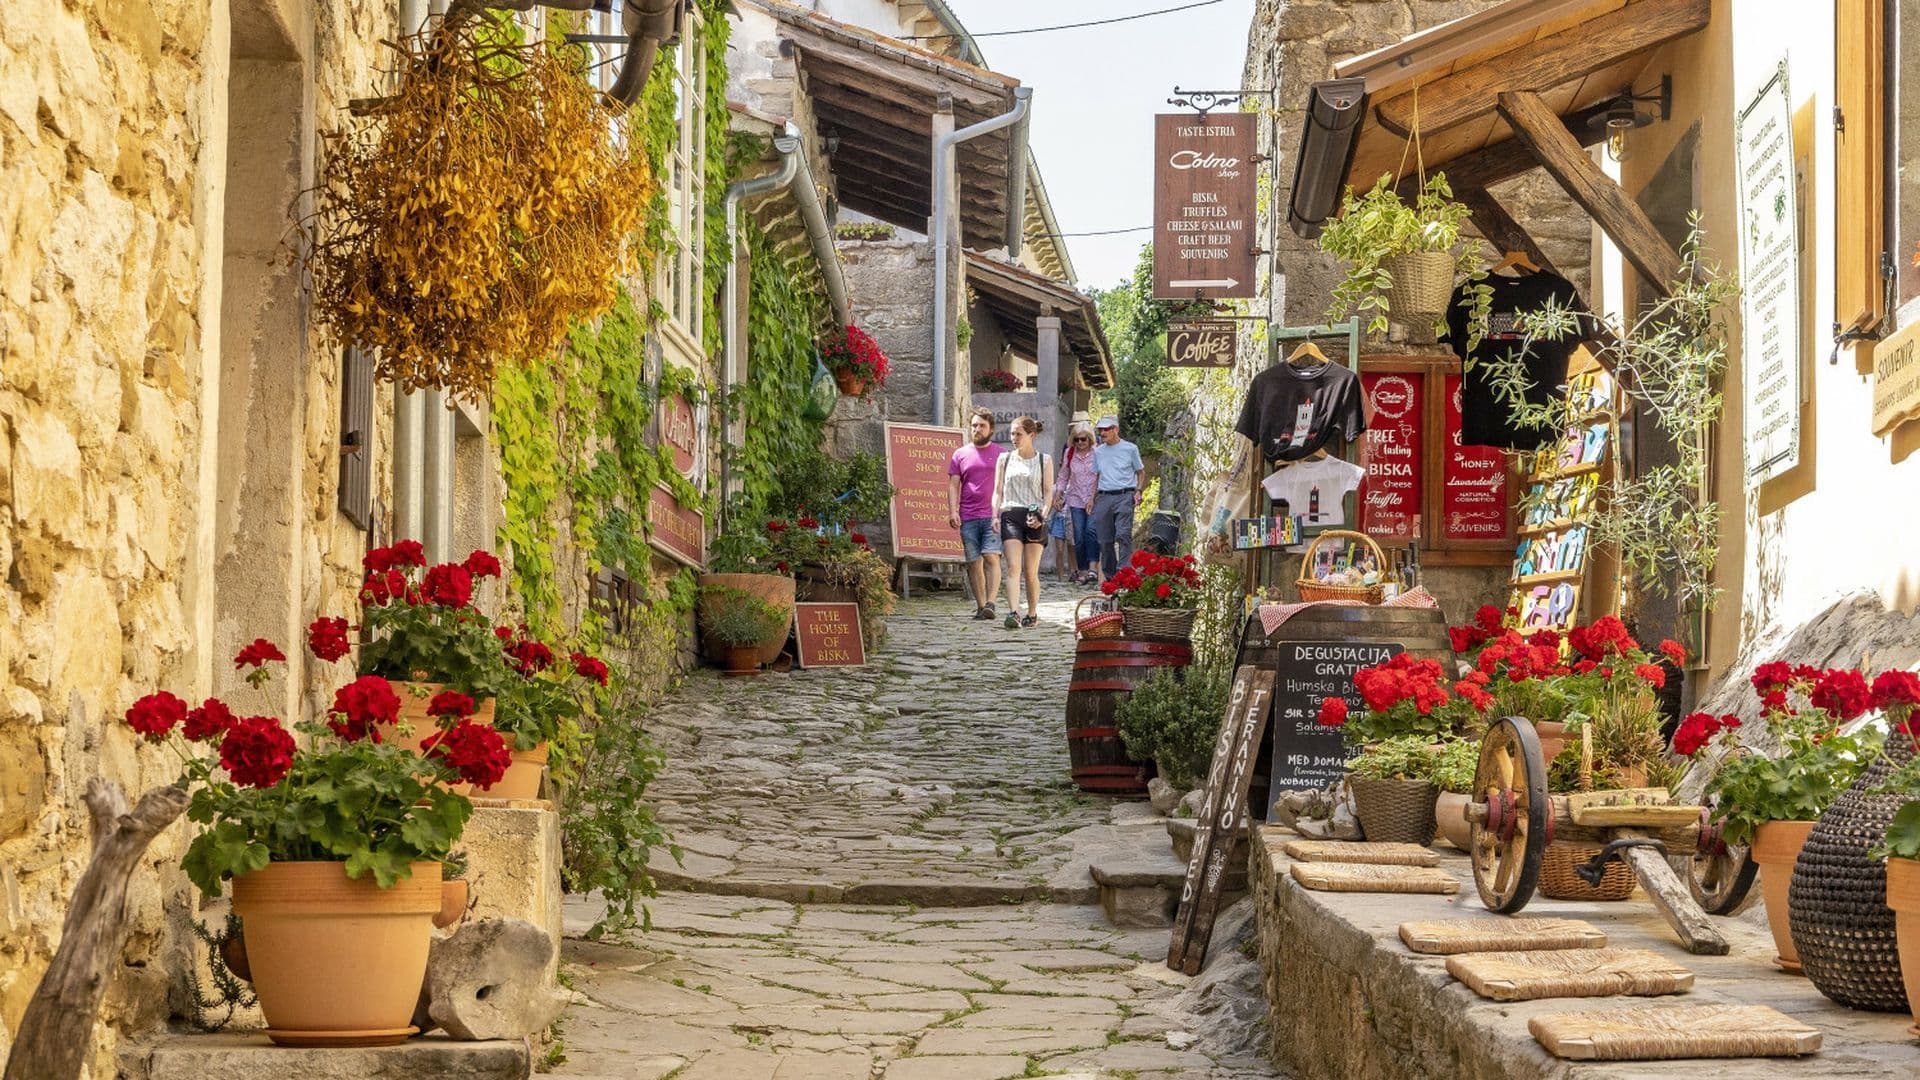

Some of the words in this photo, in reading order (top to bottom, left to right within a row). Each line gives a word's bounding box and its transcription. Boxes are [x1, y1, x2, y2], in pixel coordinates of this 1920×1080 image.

[1177, 126, 1205, 137] TASTE
[1206, 126, 1236, 137] ISTRIA
[1170, 150, 1240, 170] Colmo
[1217, 167, 1240, 179] shop
[1192, 192, 1218, 203] BISKA
[1182, 206, 1228, 217] TRUFFLES
[1167, 220, 1200, 231] CHEESE
[1210, 220, 1243, 231] SALAMI
[1178, 235, 1206, 246] CRAFT
[1207, 235, 1232, 246] BEER
[1180, 249, 1229, 260] SOUVENIRS
[893, 434, 958, 448] TRADITIONAL
[1366, 429, 1397, 443] FREE
[907, 448, 946, 460] ISTRIAN
[1383, 444, 1412, 458] tasting
[915, 463, 941, 473] SHOP
[1368, 464, 1413, 476] BISKA
[1460, 460, 1496, 469] HONEY
[1383, 480, 1412, 489] Cheese
[1364, 489, 1403, 508] Truffles
[900, 536, 922, 547] FREE
[814, 610, 841, 621] THE
[809, 623, 850, 635] HOUSE
[823, 636, 840, 648] OF
[817, 649, 850, 661] BISKA
[1294, 645, 1393, 665] DEGUSTACIJA
[1200, 680, 1245, 820] BISKA
[1220, 689, 1267, 830] TERANINO
[1287, 754, 1310, 765] MED
[1279, 777, 1326, 787] KOBASICE
[1182, 833, 1207, 903] MED
